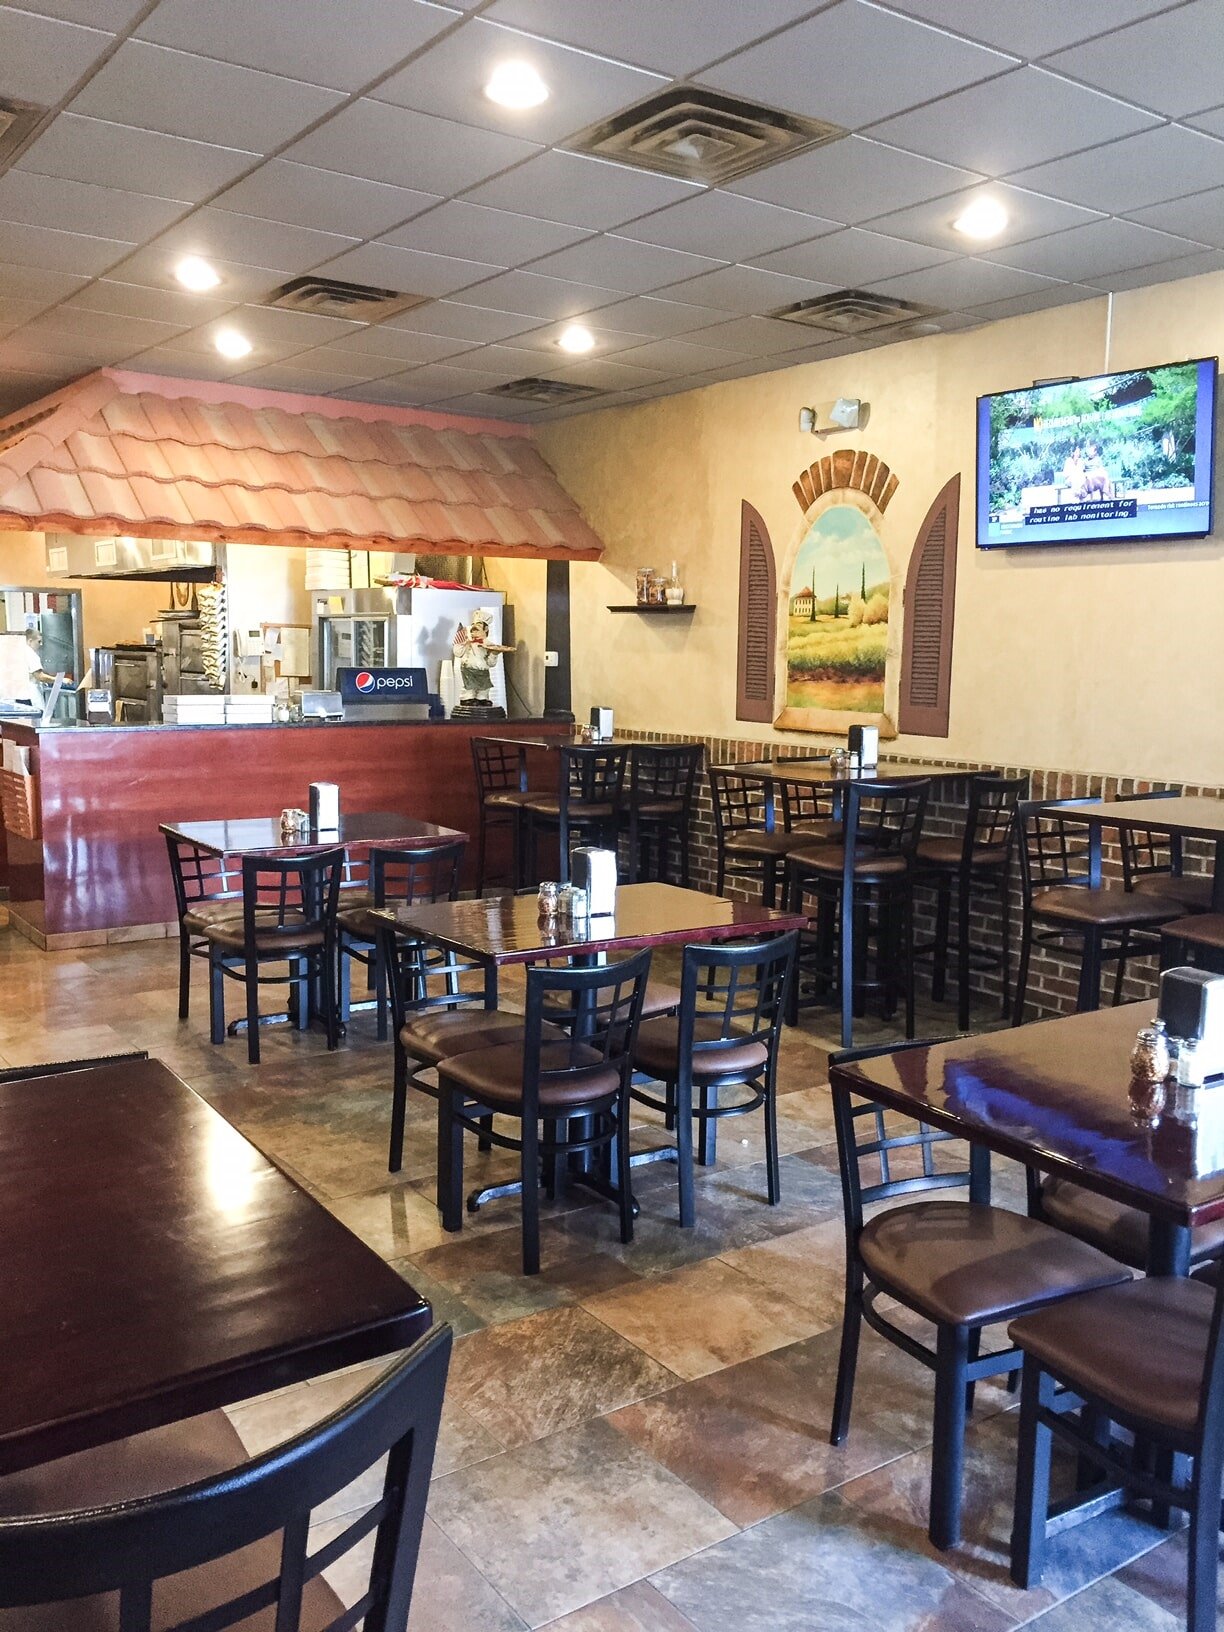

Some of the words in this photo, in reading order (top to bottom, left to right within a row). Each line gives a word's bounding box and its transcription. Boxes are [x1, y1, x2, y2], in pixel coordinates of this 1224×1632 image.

[1064, 502, 1114, 513] requirement
[1118, 500, 1134, 508] for
[1029, 516, 1060, 524] routine
[1065, 513, 1077, 521] lab
[377, 675, 413, 689] pepsi
